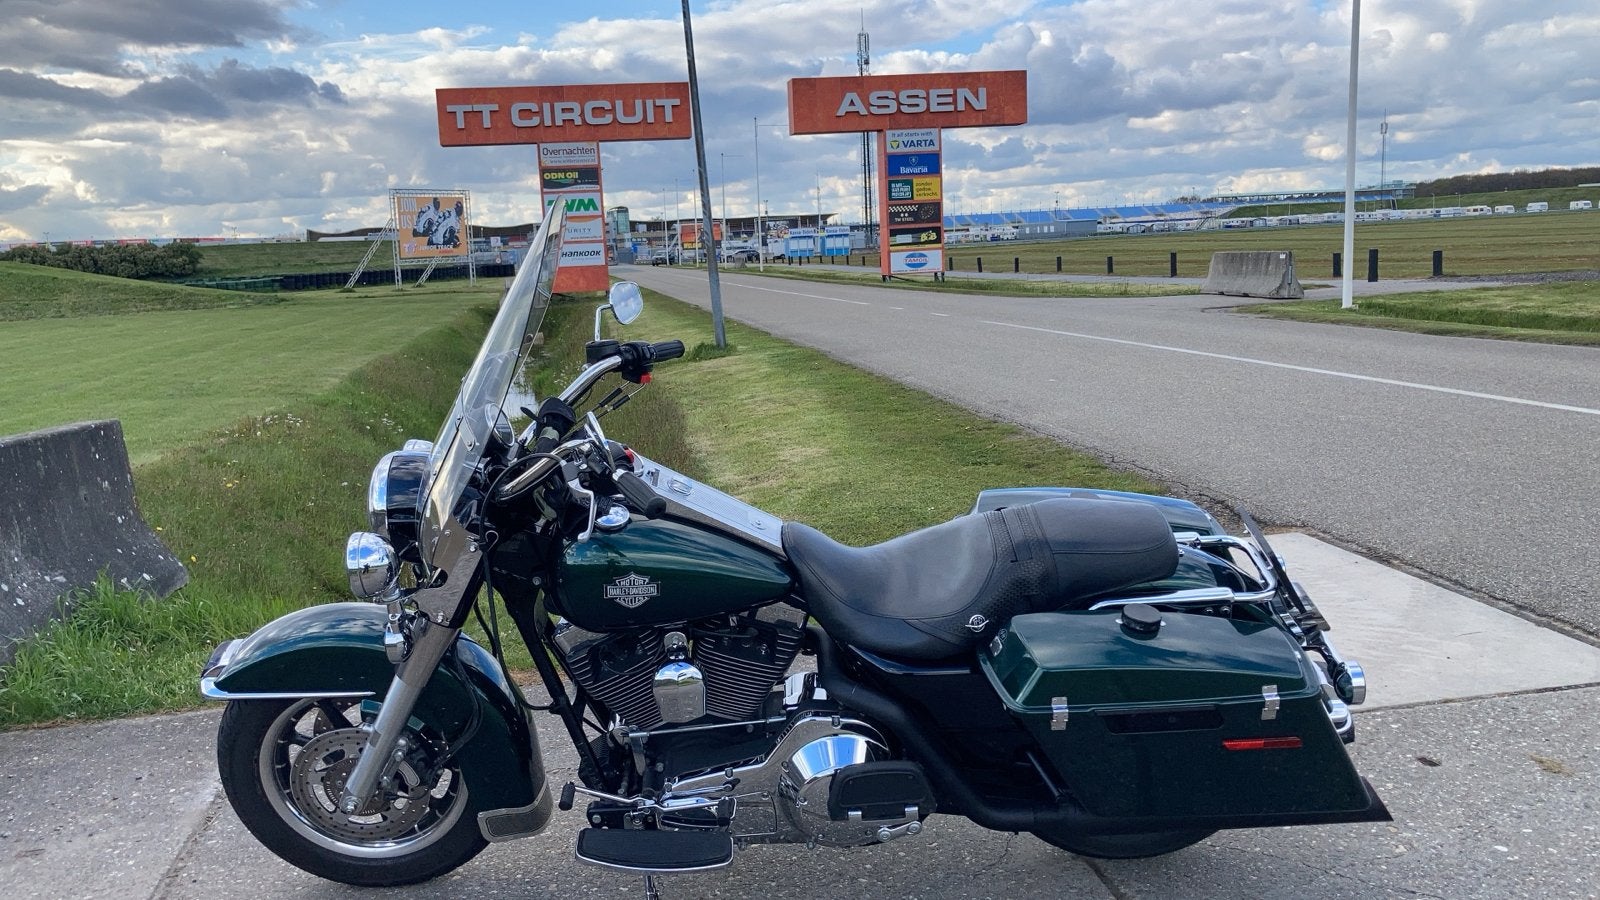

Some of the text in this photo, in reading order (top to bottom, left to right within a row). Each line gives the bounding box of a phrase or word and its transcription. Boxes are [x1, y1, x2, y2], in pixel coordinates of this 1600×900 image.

[836, 87, 987, 116] ASSEN
[446, 98, 680, 129] TT CIRCUIT
[902, 140, 935, 148] VARTA
[542, 146, 596, 156] Overnachten
[900, 166, 928, 174] Bavaria
[544, 172, 565, 180] ODN
[620, 577, 644, 586] MOTOR
[609, 586, 654, 596] HARLEY-DAVIDSON
[620, 596, 644, 606] CYCLES
